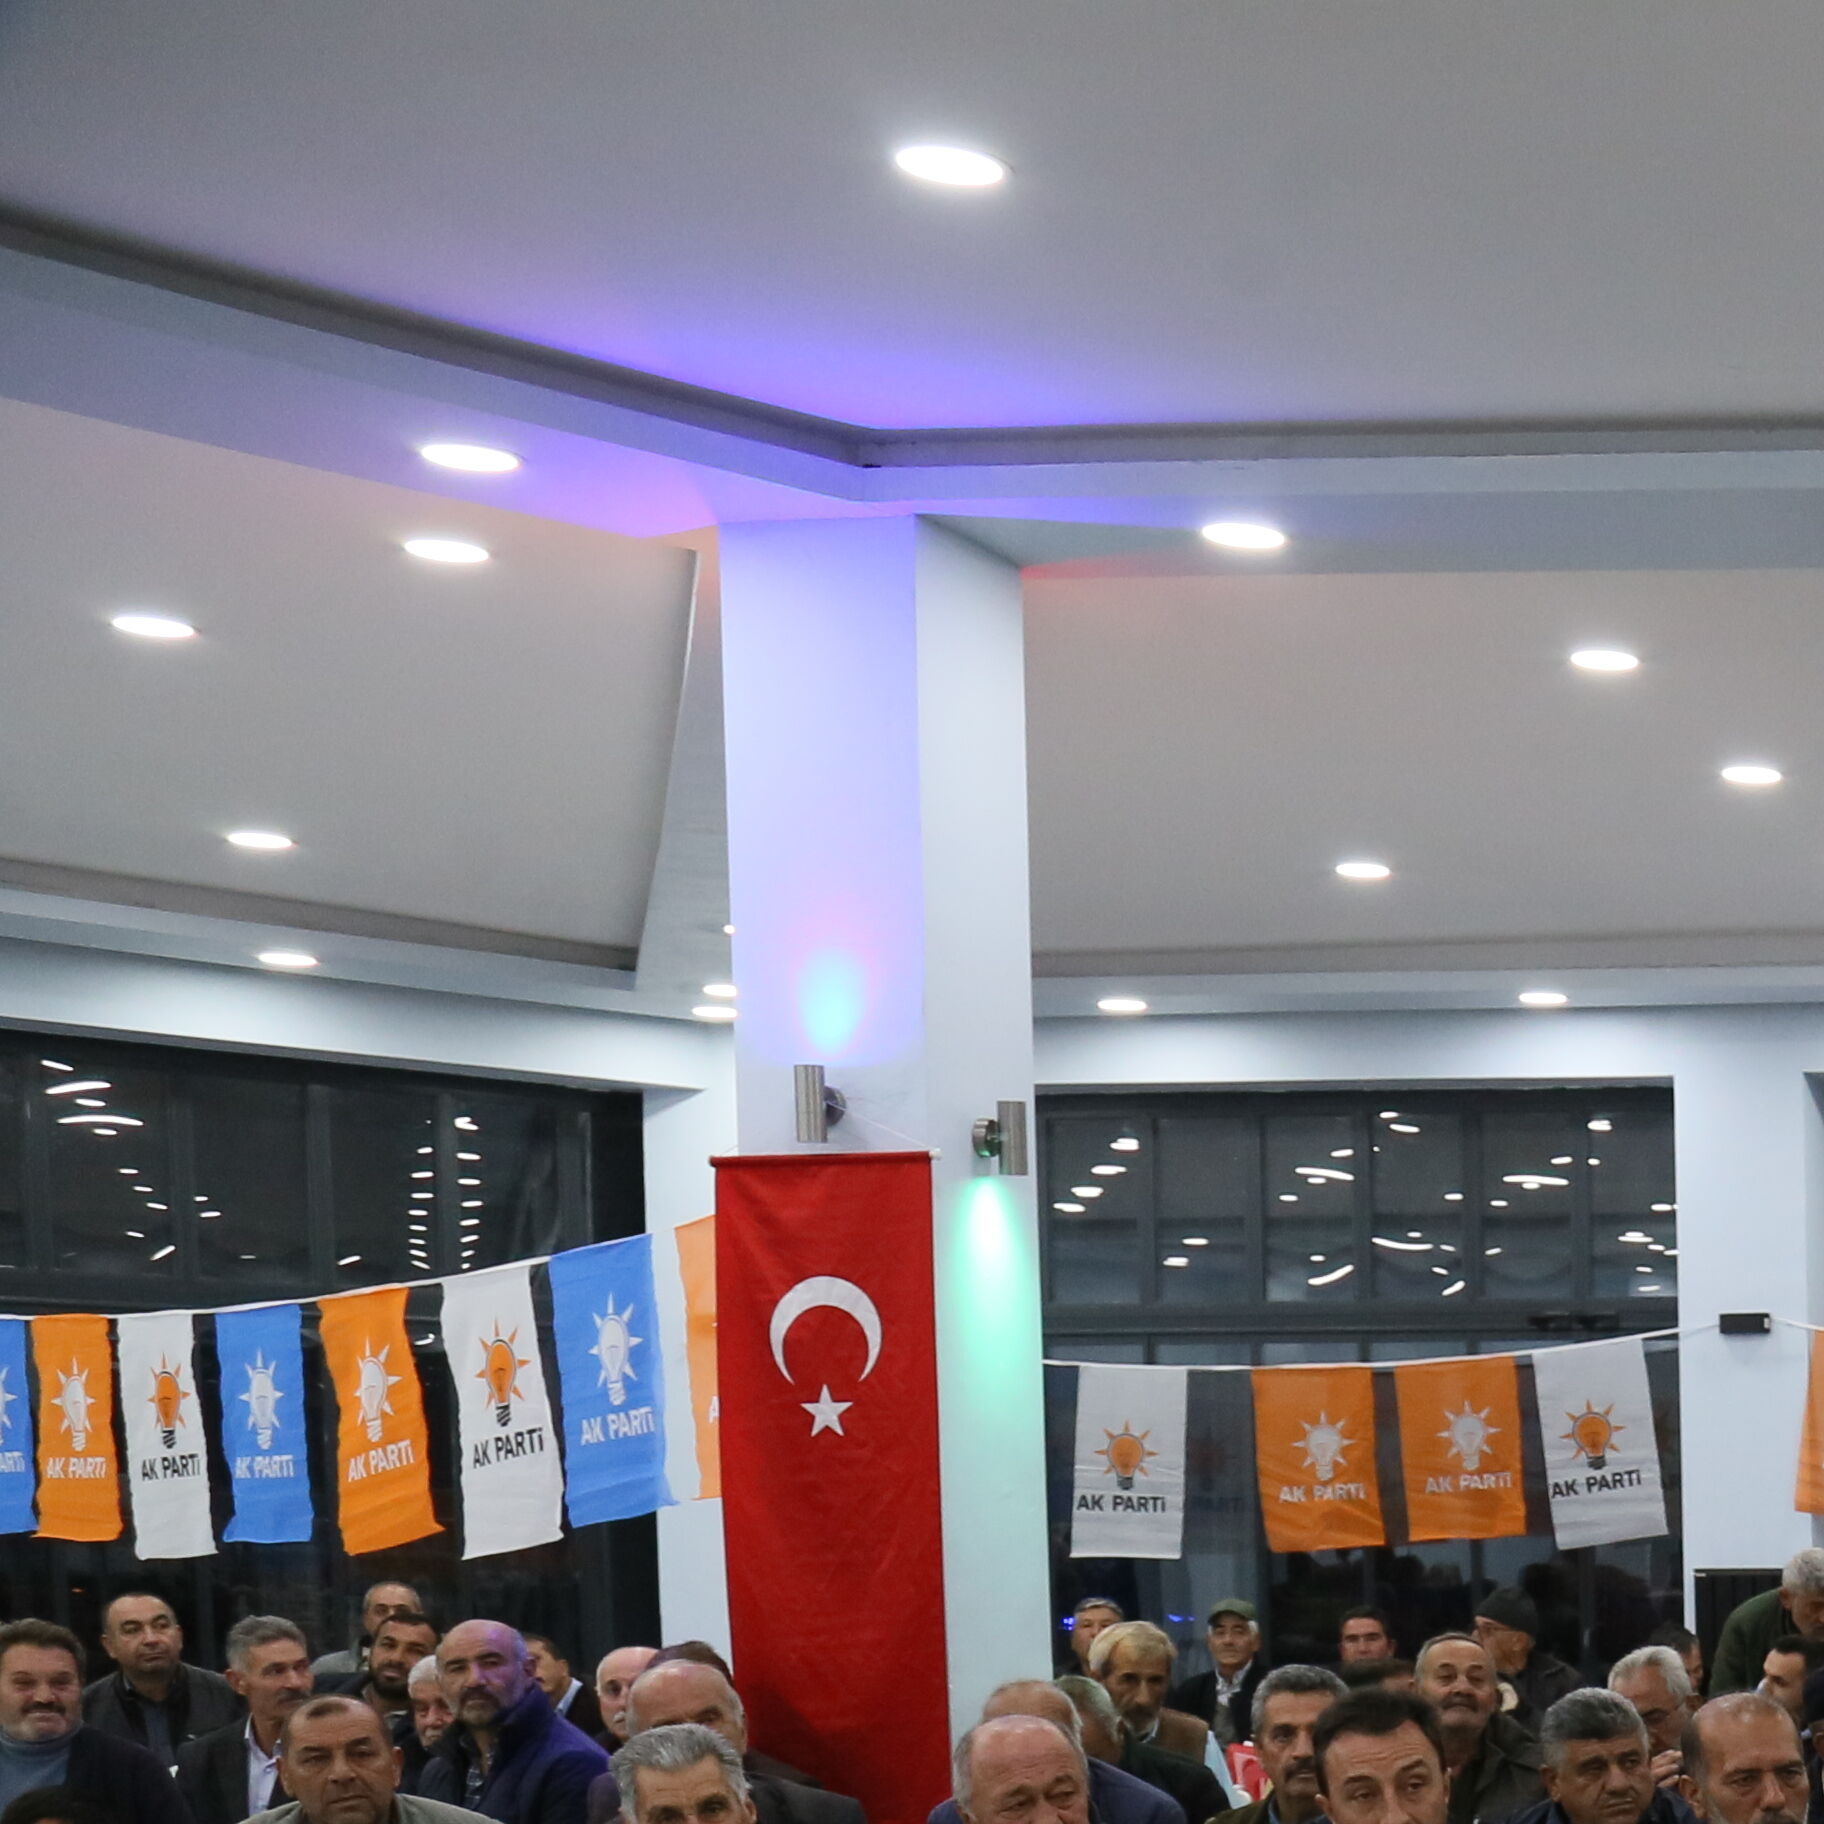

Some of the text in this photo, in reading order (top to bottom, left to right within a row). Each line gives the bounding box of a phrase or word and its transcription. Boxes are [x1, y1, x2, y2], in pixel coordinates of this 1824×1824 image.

[708, 1395, 719, 1424] A
[581, 1418, 603, 1446] AK
[472, 1440, 493, 1469] AK
[47, 1458, 63, 1478] AK
[141, 1458, 158, 1482] AK
[236, 1456, 251, 1477] AK
[348, 1455, 368, 1482] AK
[1279, 1486, 1306, 1503] AK
[1425, 1476, 1452, 1494] AK
[1551, 1480, 1579, 1500] AK
[1077, 1494, 1104, 1512] AK
